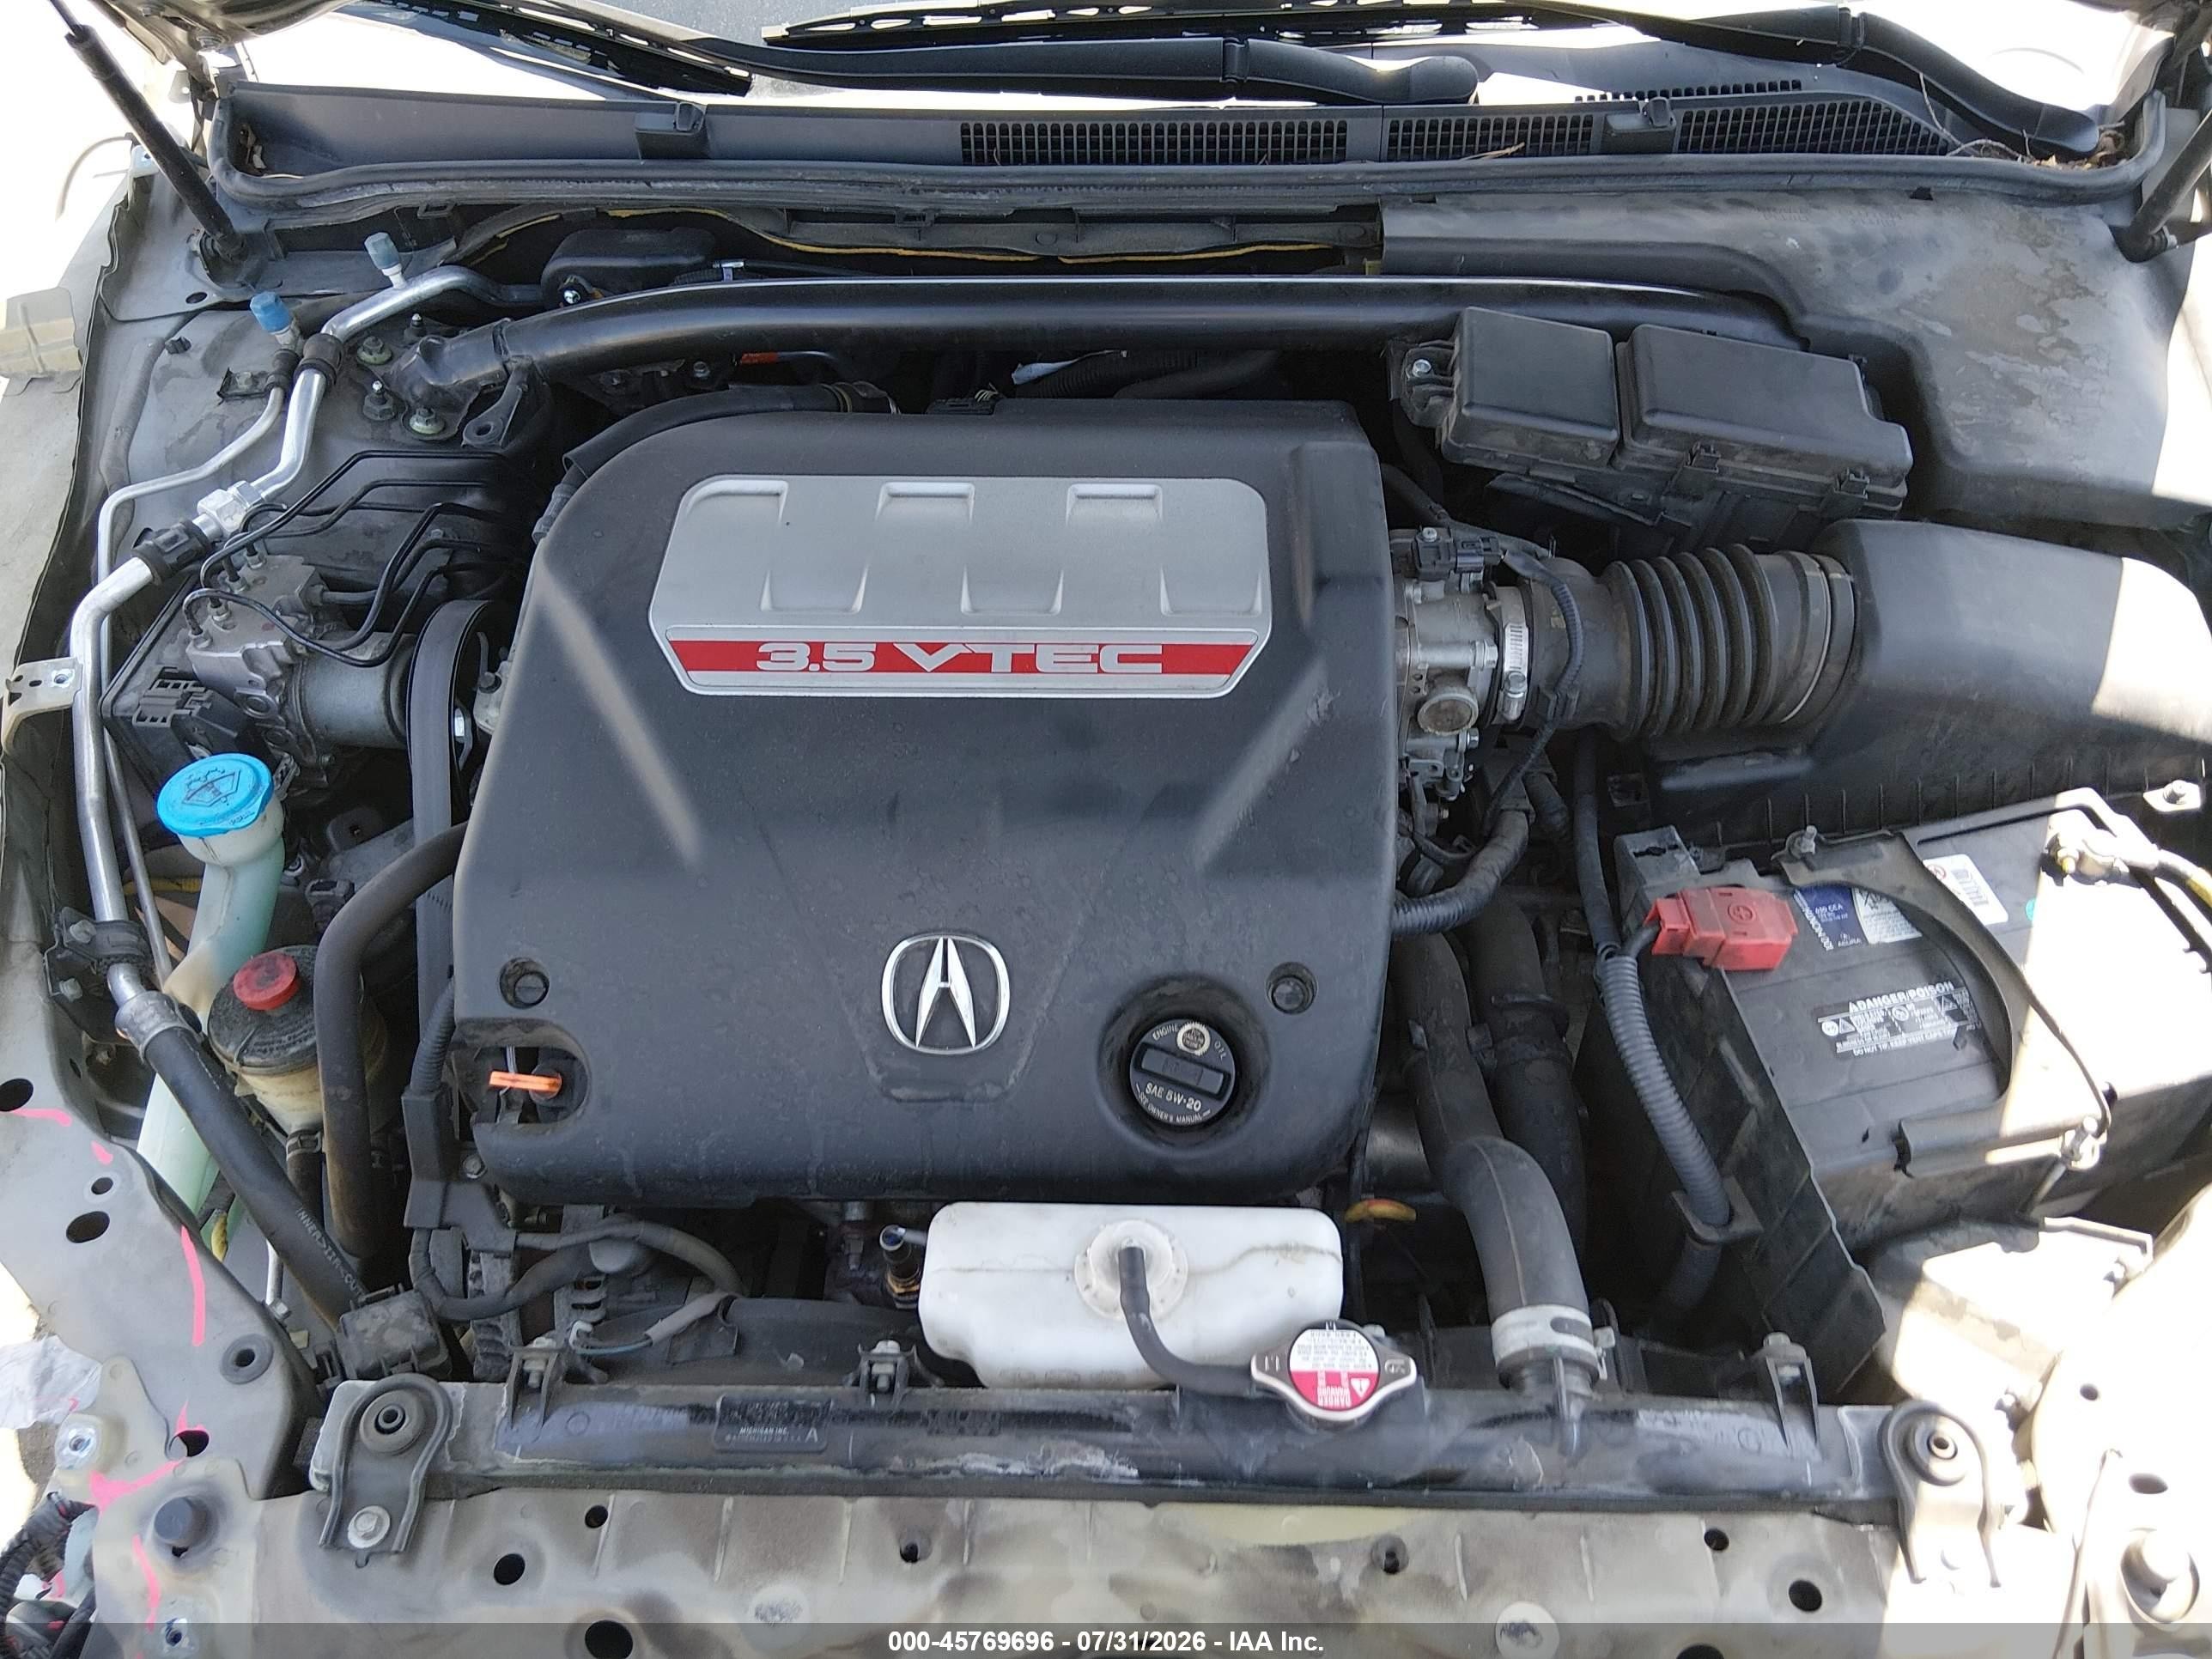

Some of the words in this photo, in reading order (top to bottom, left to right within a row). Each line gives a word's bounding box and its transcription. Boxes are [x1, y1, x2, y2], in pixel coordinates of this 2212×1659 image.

[757, 642, 877, 672] 3.5
[893, 642, 1163, 674] VTEC
[1152, 1024, 1179, 1041] ENGINE
[1214, 1041, 1227, 1060] OIL
[1146, 1082, 1163, 1098] SAE
[1165, 1090, 1202, 1112] 5W-20
[1176, 1114, 1202, 1124] MANUAL
[804, 1427, 818, 1443] A
